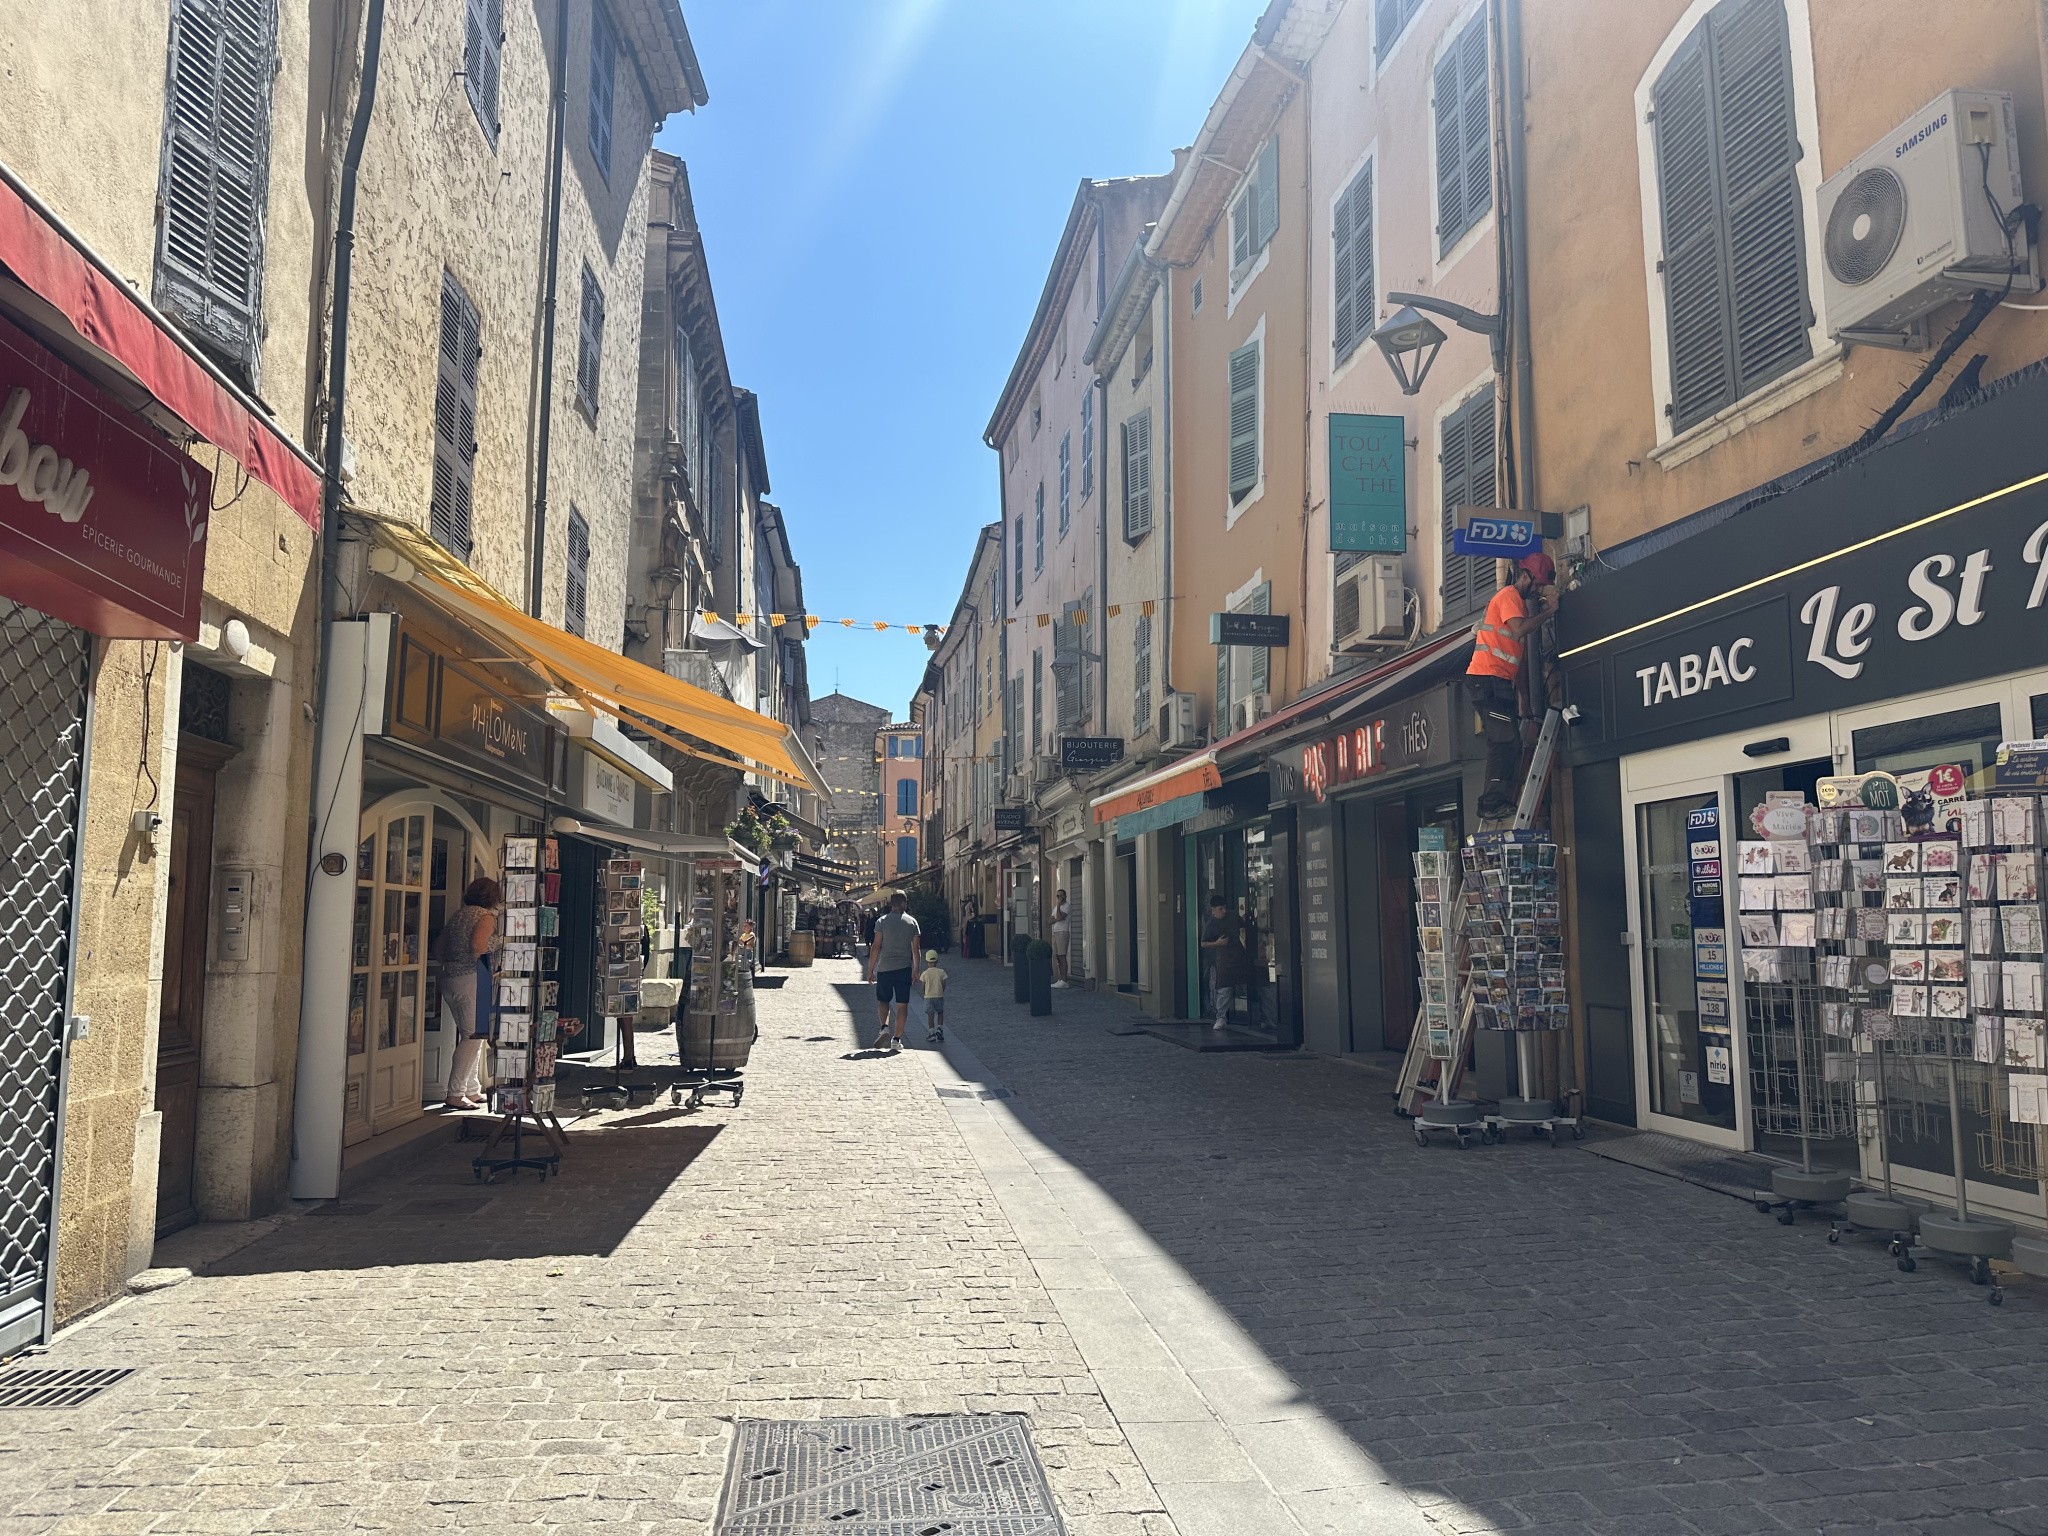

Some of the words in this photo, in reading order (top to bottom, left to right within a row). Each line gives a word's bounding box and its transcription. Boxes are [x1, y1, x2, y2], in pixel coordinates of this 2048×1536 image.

[1895, 113, 1948, 158] SAMSUNG
[1335, 521, 1399, 532] maison
[1470, 521, 1508, 540] FDJ
[1335, 534, 1356, 544] de
[1369, 535, 1399, 546] thé
[82, 524, 124, 558] EPICERIE
[126, 547, 182, 588] GOURMANDE
[1800, 585, 1877, 680] Le
[1897, 548, 1994, 642] St
[1636, 636, 1757, 707] TABAC
[1402, 711, 1429, 755] THÉS
[1066, 741, 1118, 749] BIJOUTERIE
[1276, 763, 1295, 794] VINS
[1936, 768, 1955, 783] 1€
[1869, 790, 1891, 807] MOT
[1937, 795, 1965, 805] CARRÉ
[1690, 812, 1706, 826] FDJ
[1775, 810, 1795, 818] Vive
[1707, 950, 1717, 960] 15
[1706, 1002, 1720, 1013] 138
